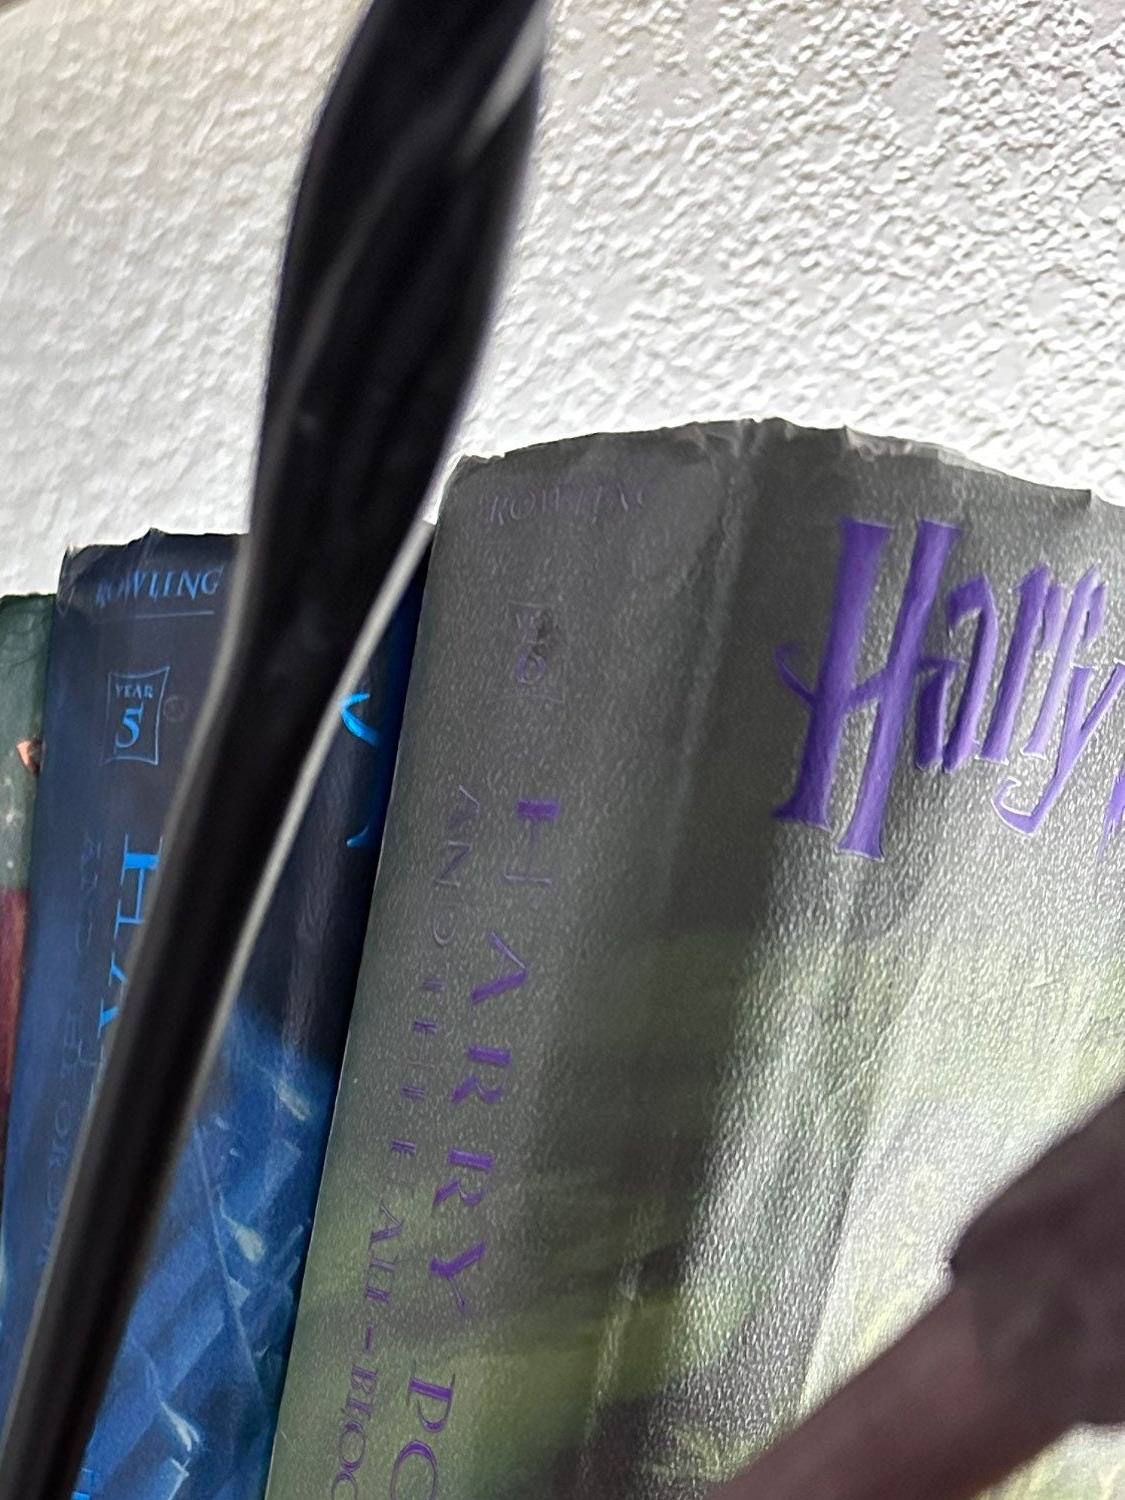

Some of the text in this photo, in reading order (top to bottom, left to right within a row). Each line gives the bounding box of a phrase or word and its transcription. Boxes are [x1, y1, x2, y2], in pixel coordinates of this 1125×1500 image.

[114, 682, 155, 700] YEAR
[775, 516, 1125, 862] Harry
[114, 703, 145, 749] 5
